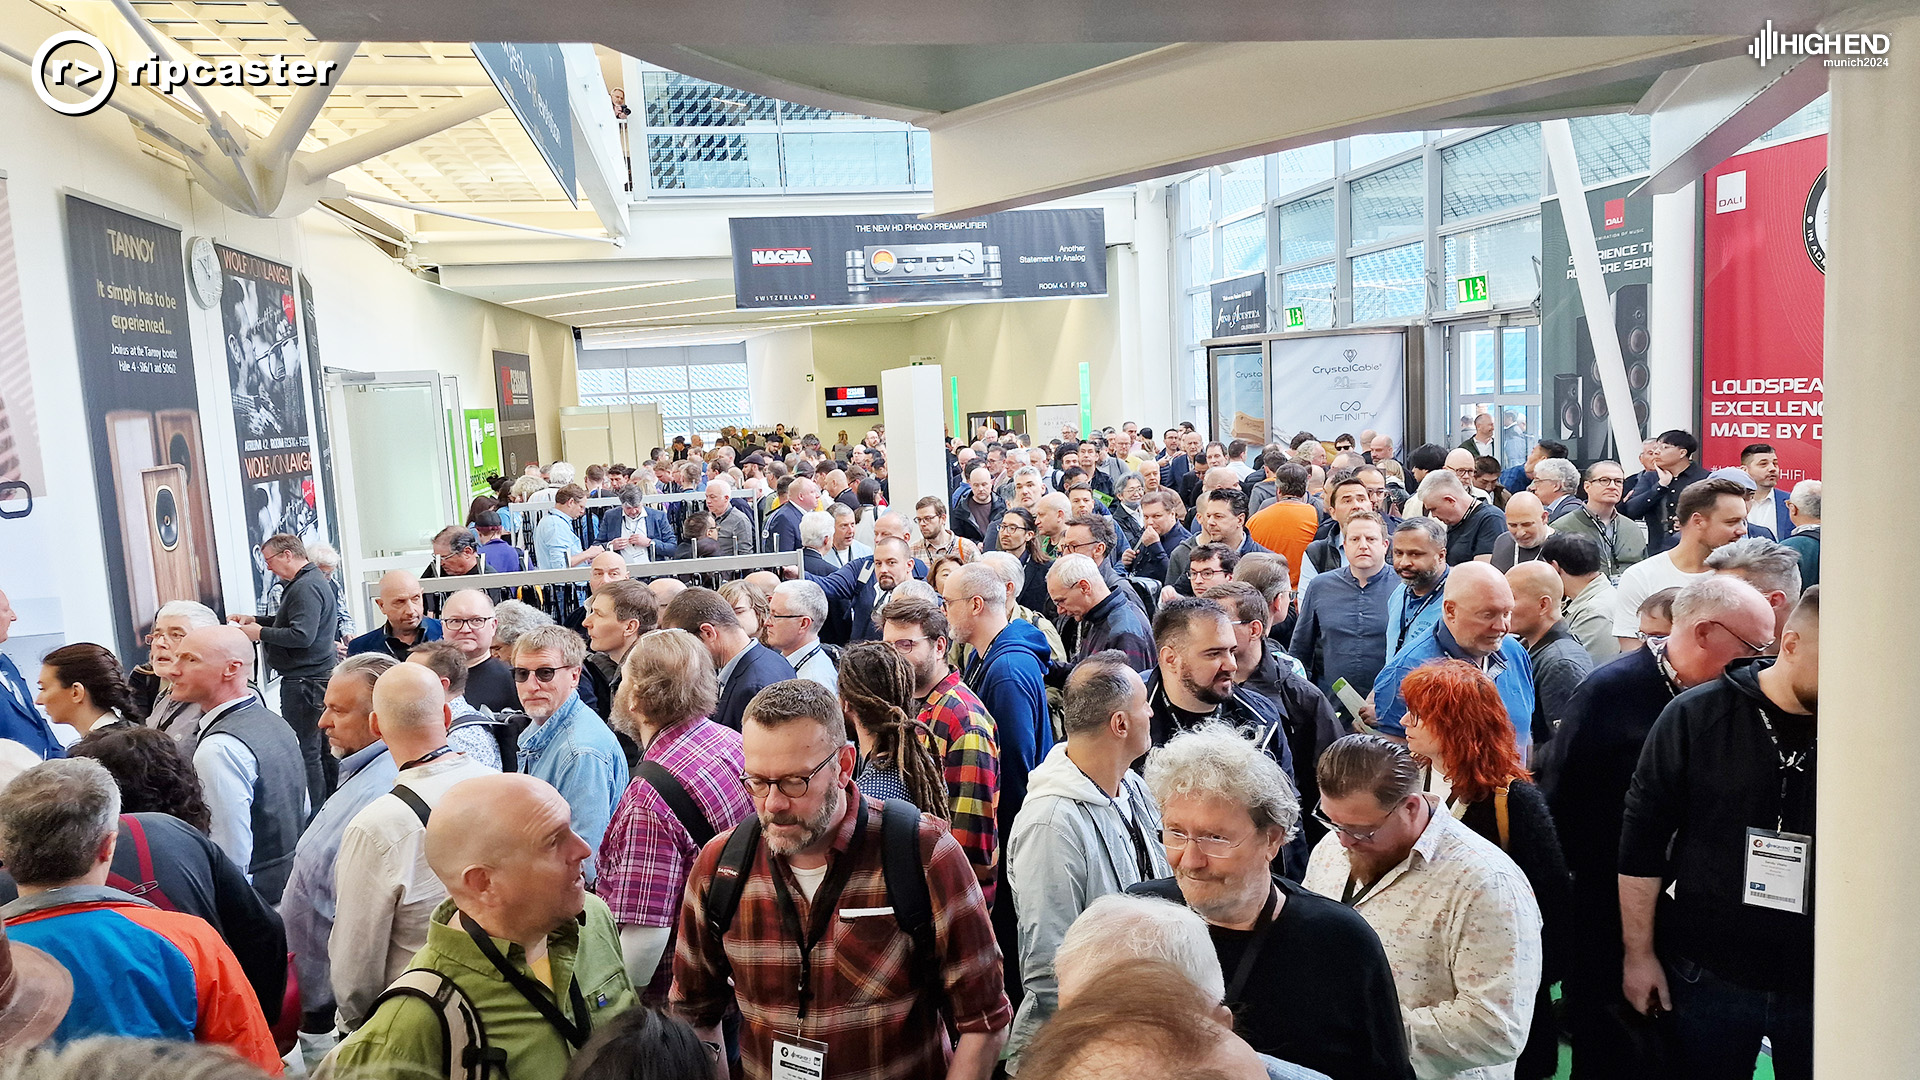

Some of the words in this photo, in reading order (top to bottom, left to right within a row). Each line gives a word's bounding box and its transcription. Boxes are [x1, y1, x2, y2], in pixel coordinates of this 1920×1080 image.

[1718, 196, 1743, 207] DALI
[855, 225, 871, 233] THE
[872, 224, 891, 232] NEW
[892, 223, 904, 231] HD
[905, 222, 933, 231] PHONO
[934, 221, 988, 230] PREAMPLIFIER
[1605, 216, 1624, 226] DALI
[1806, 229, 1815, 242] IN
[107, 228, 155, 264] TANNOY
[1059, 245, 1086, 253] Another
[751, 249, 813, 265] NAGRA
[1019, 255, 1054, 264] Statement
[1062, 254, 1086, 263] Analog
[96, 278, 106, 298] It
[107, 281, 137, 308] simply
[138, 286, 154, 306] has
[155, 292, 165, 308] to
[165, 291, 177, 310] be
[754, 294, 809, 302] SWITZERLAND
[1235, 370, 1263, 379] Crysta
[1711, 377, 1824, 395] LOUDSPEA
[1319, 411, 1378, 423] INFINITY
[1710, 422, 1771, 438] MADE
[1776, 423, 1807, 439] BY
